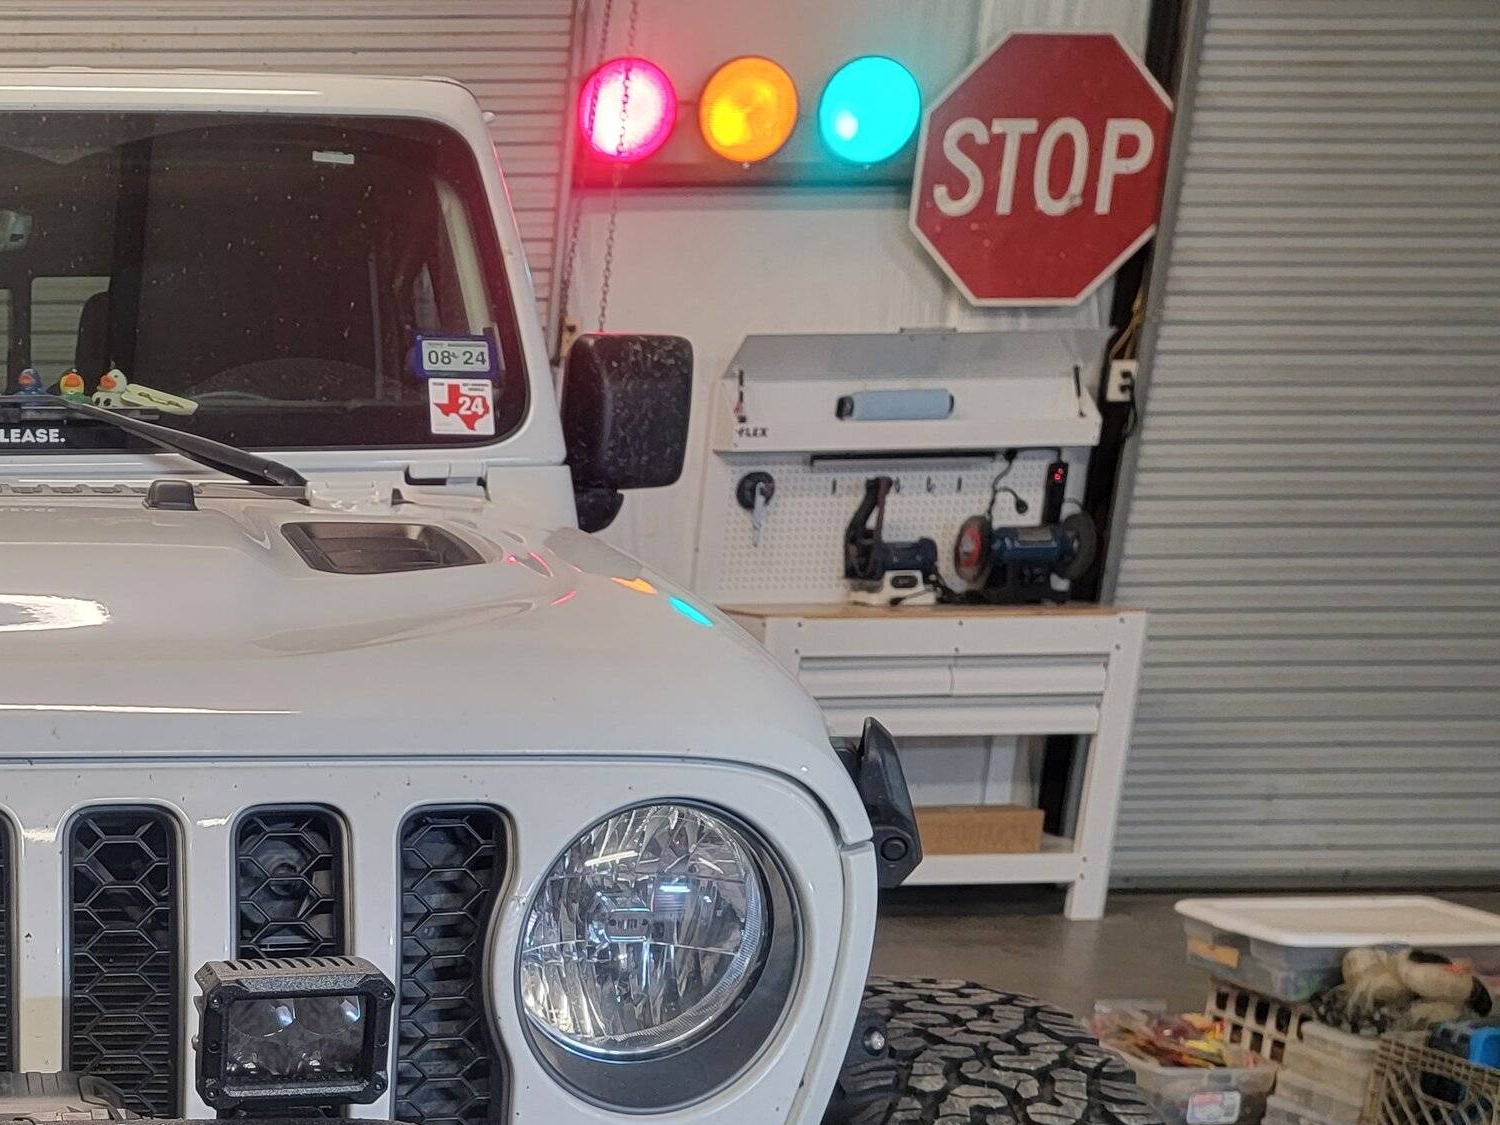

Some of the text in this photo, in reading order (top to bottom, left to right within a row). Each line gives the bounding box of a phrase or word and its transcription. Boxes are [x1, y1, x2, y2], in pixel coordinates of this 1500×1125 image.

[932, 117, 1155, 217] STOP
[428, 350, 487, 366] 08 24
[457, 396, 486, 416] 24
